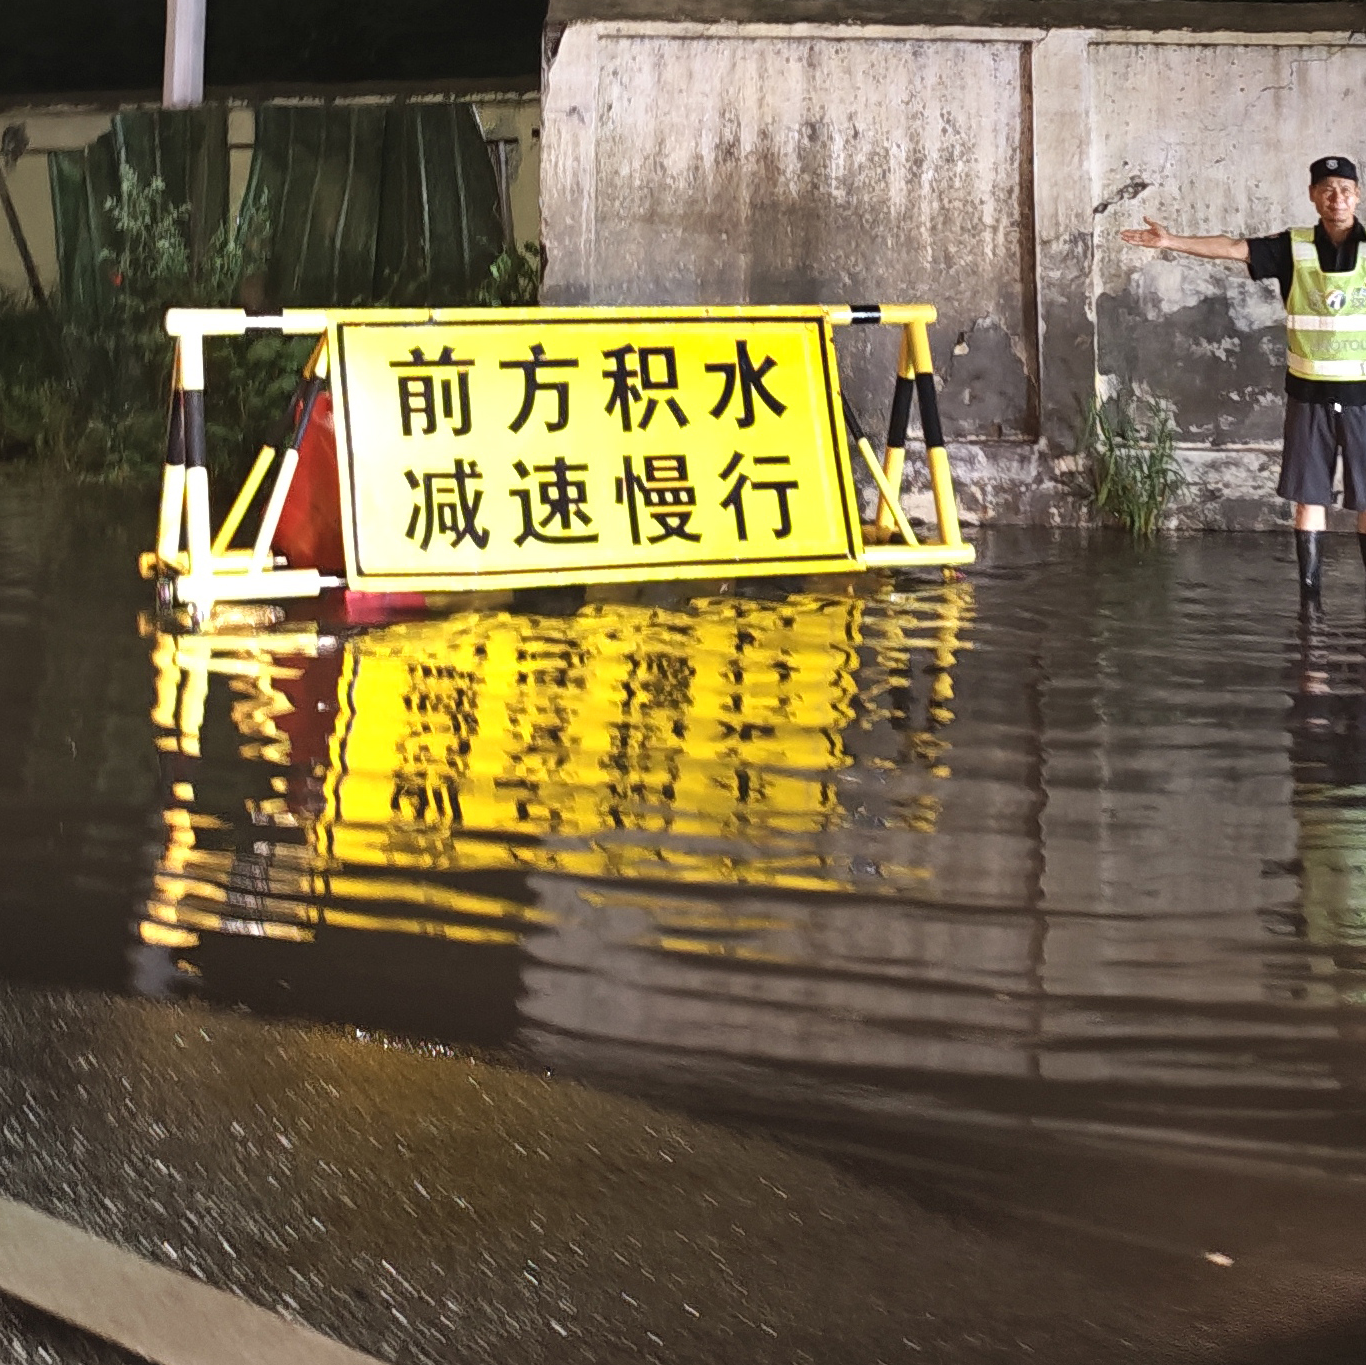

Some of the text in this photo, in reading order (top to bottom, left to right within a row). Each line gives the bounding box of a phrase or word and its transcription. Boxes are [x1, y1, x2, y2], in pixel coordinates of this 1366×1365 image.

[389, 340, 787, 436] 前方积水
[403, 450, 800, 551] 减速慢行
